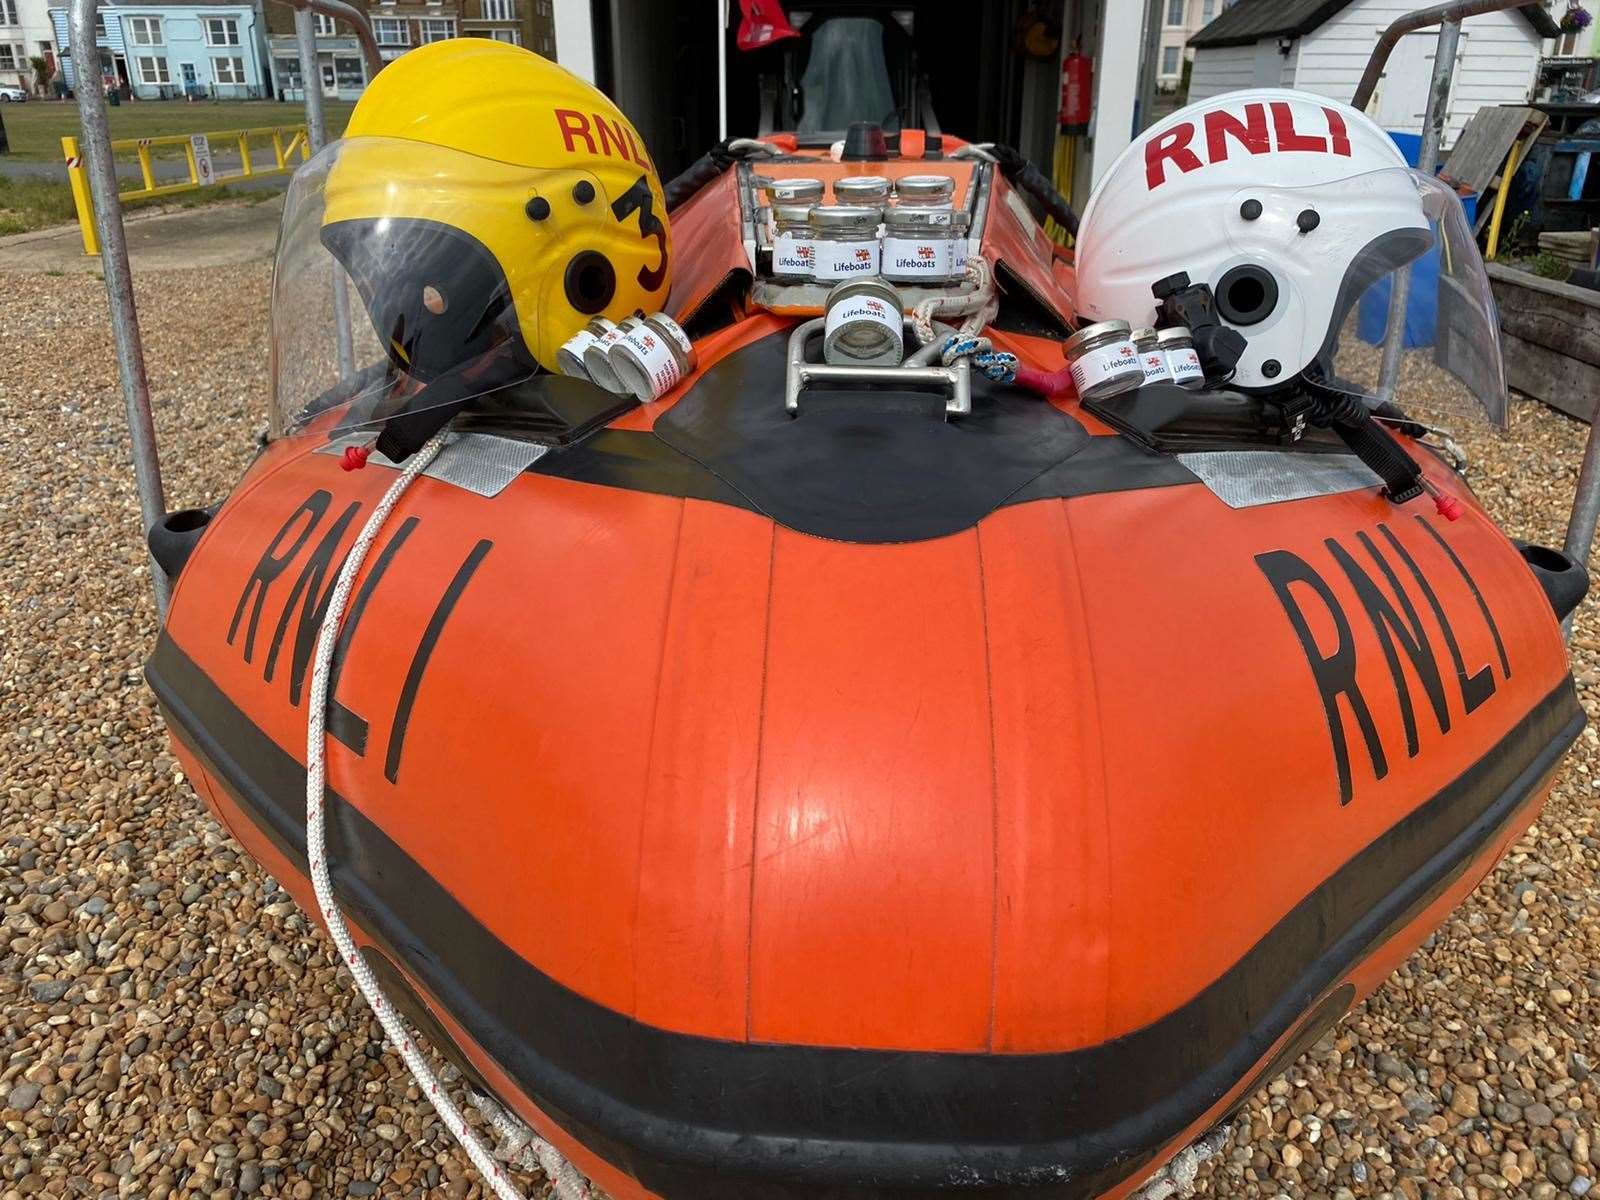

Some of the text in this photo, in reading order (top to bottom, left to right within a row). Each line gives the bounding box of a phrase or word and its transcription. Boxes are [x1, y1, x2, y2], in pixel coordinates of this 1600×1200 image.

[554, 108, 651, 172] RNL
[1145, 101, 1352, 191] RNLI
[610, 174, 669, 292] 3
[779, 257, 809, 268] Lifeboat
[833, 261, 872, 272] Lifeboats
[896, 258, 936, 268] Lifeboats
[842, 308, 886, 319] Lifeboats
[1102, 357, 1137, 372] Lifeboats
[1144, 366, 1166, 377] boats
[226, 488, 494, 785] RNLI
[1253, 514, 1512, 809] RNLI
